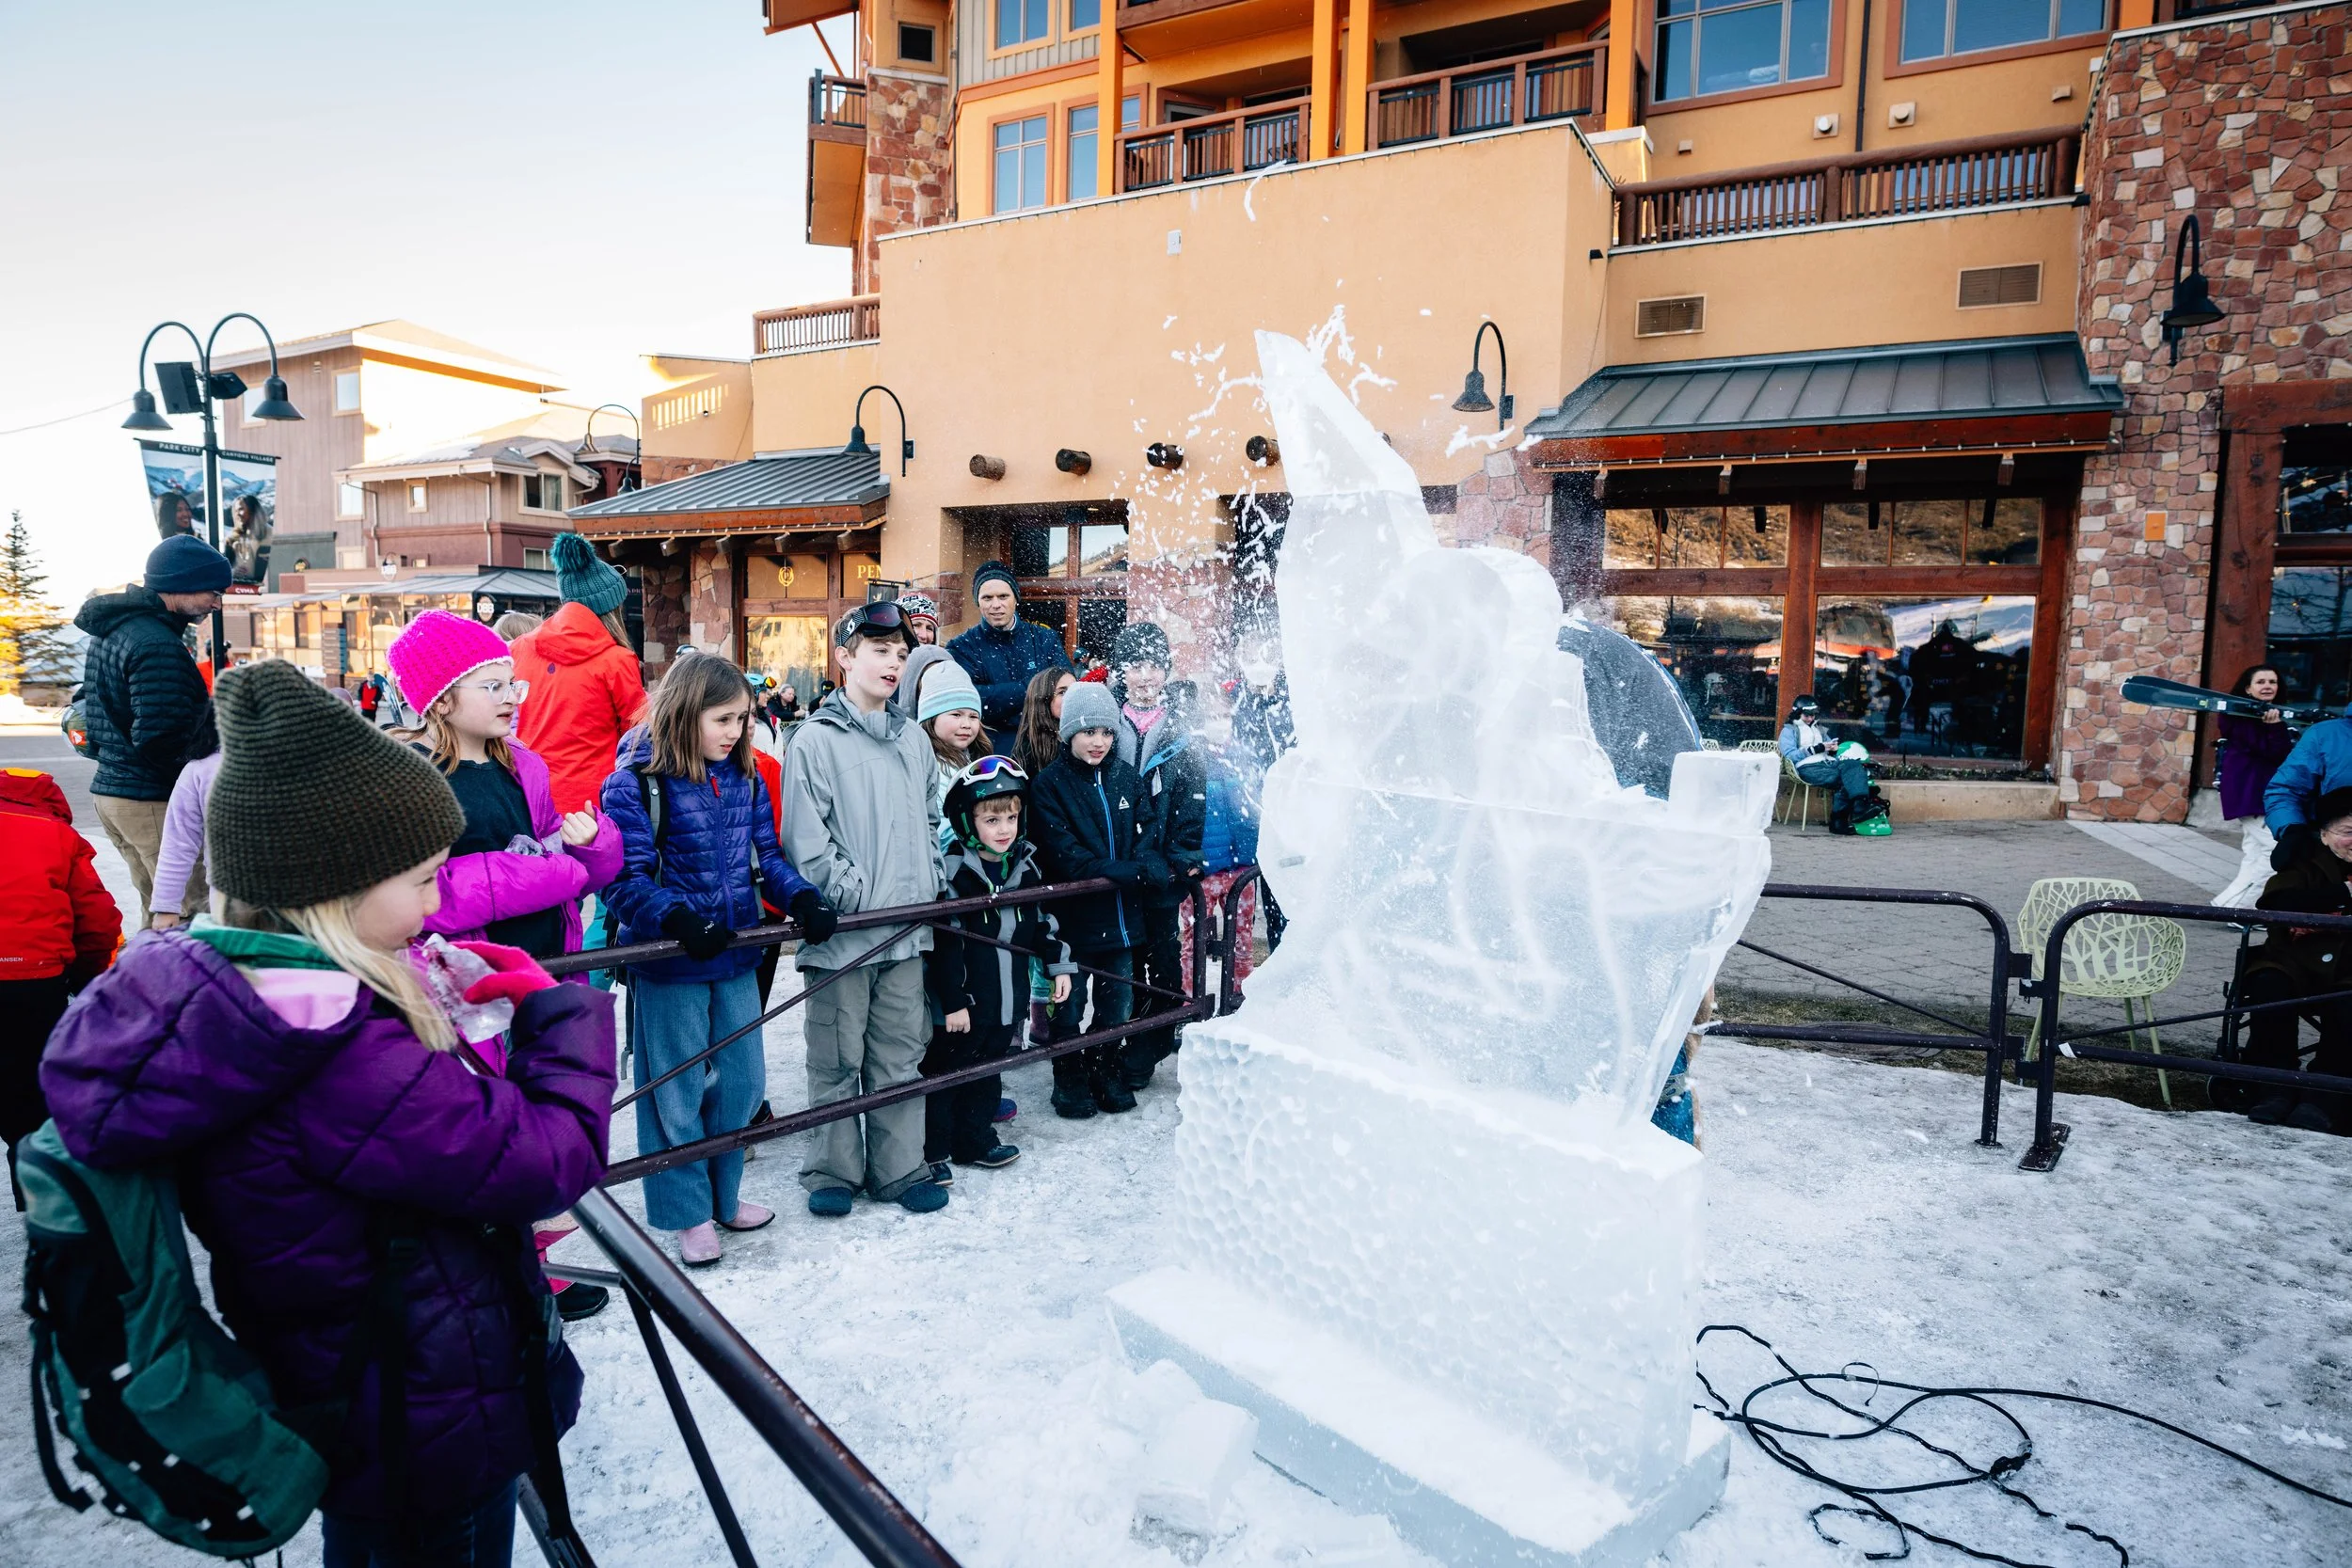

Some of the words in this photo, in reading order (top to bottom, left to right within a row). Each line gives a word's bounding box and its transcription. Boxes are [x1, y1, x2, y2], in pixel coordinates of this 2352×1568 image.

[182, 445, 200, 453] CITY
[221, 451, 249, 459] CANYONS
[250, 454, 274, 463] VILLAGE
[476, 602, 495, 614] DBB
